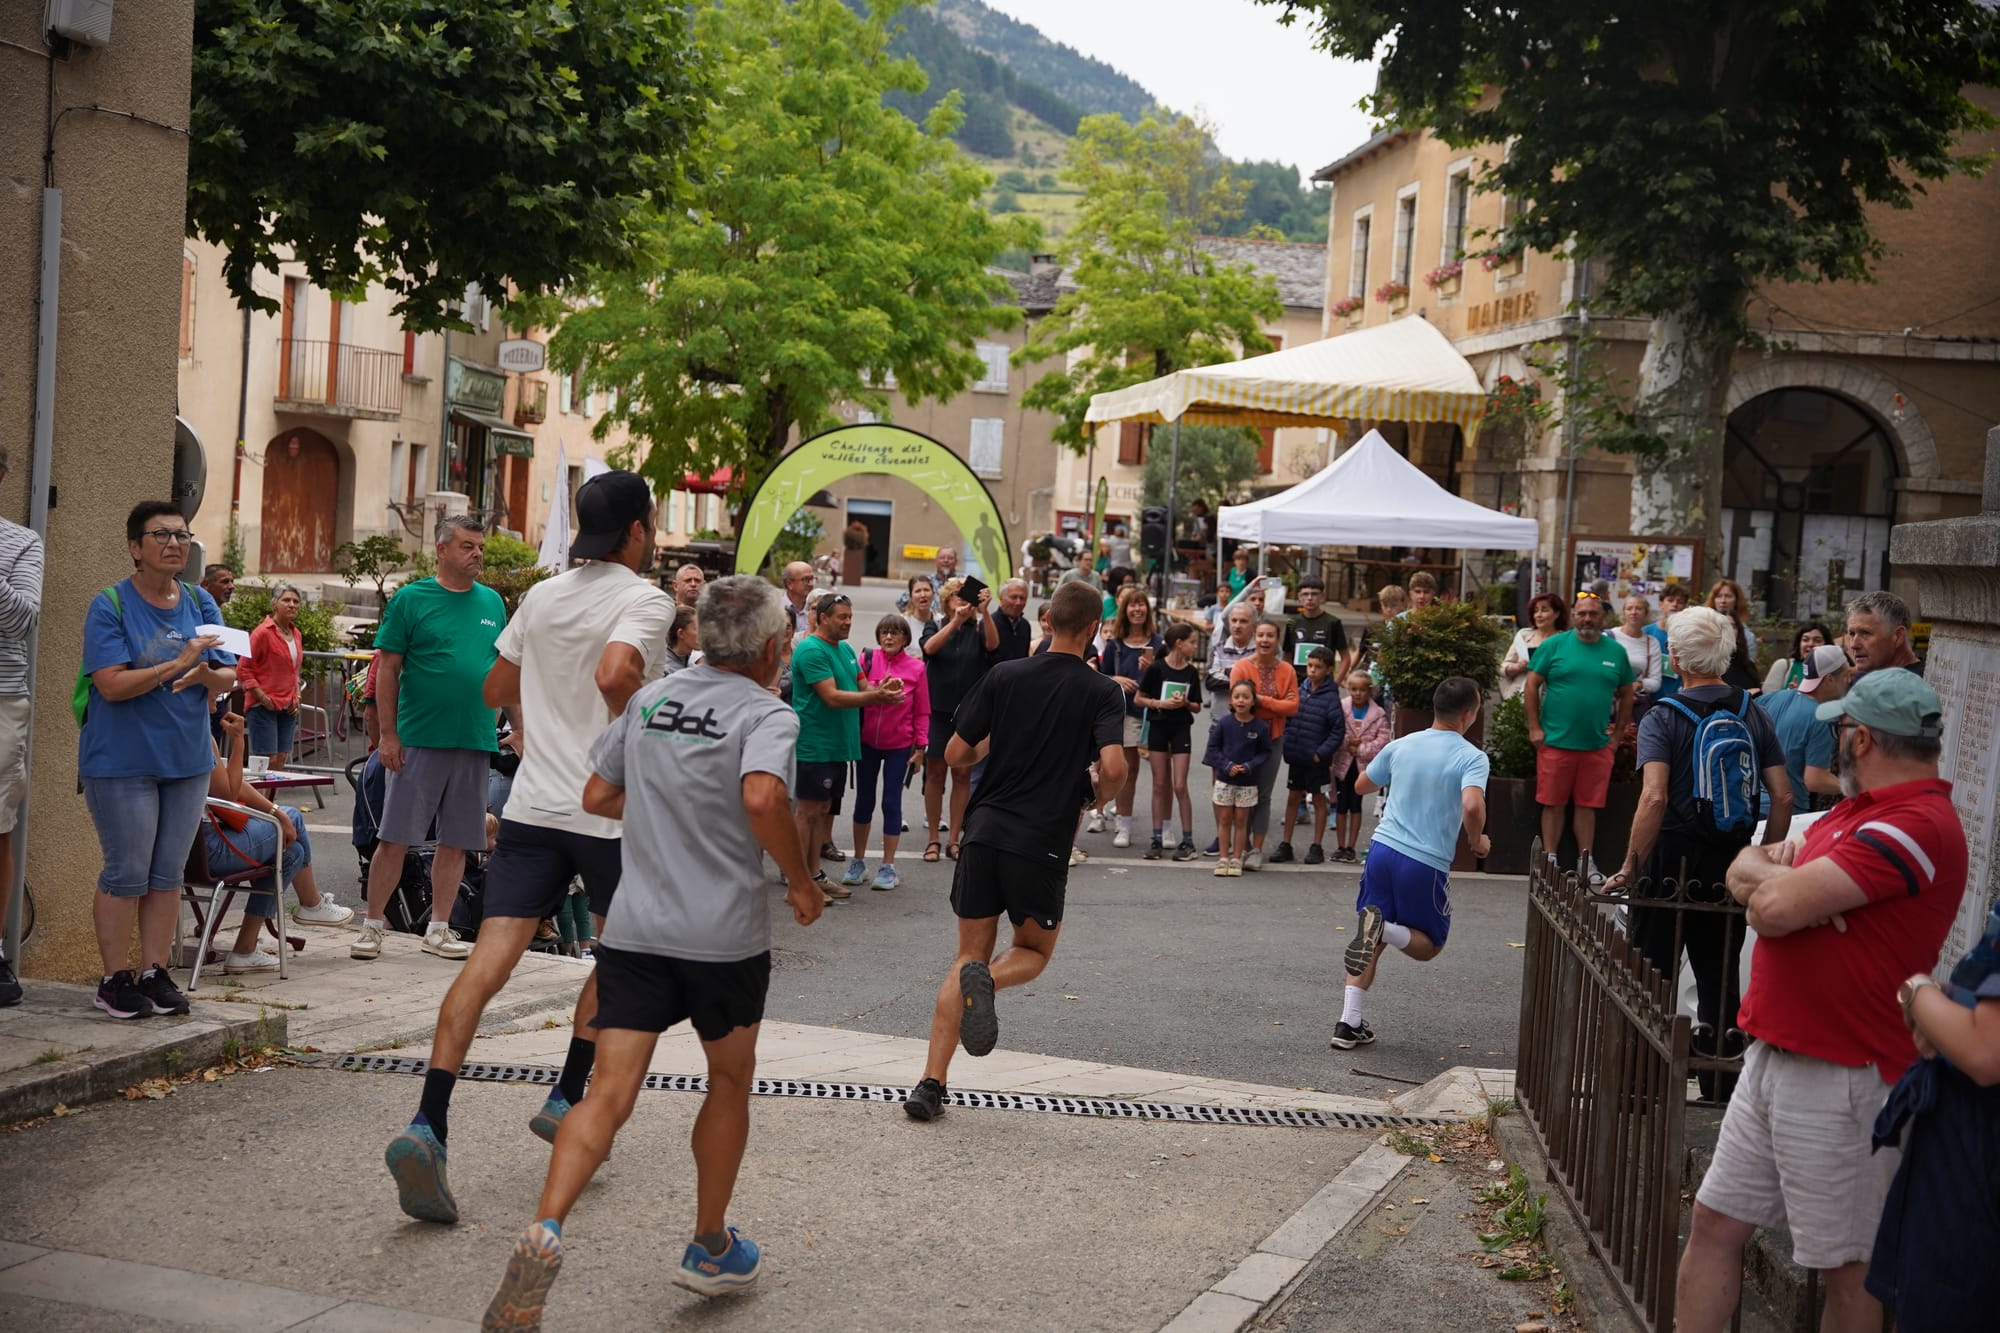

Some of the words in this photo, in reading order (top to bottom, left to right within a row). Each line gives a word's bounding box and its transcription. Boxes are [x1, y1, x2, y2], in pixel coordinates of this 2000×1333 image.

[1467, 290, 1536, 331] MAIRIE
[503, 347, 538, 365] PIZZERIA
[830, 439, 894, 455] Challenge
[901, 444, 923, 454] des
[822, 452, 867, 464] vallées
